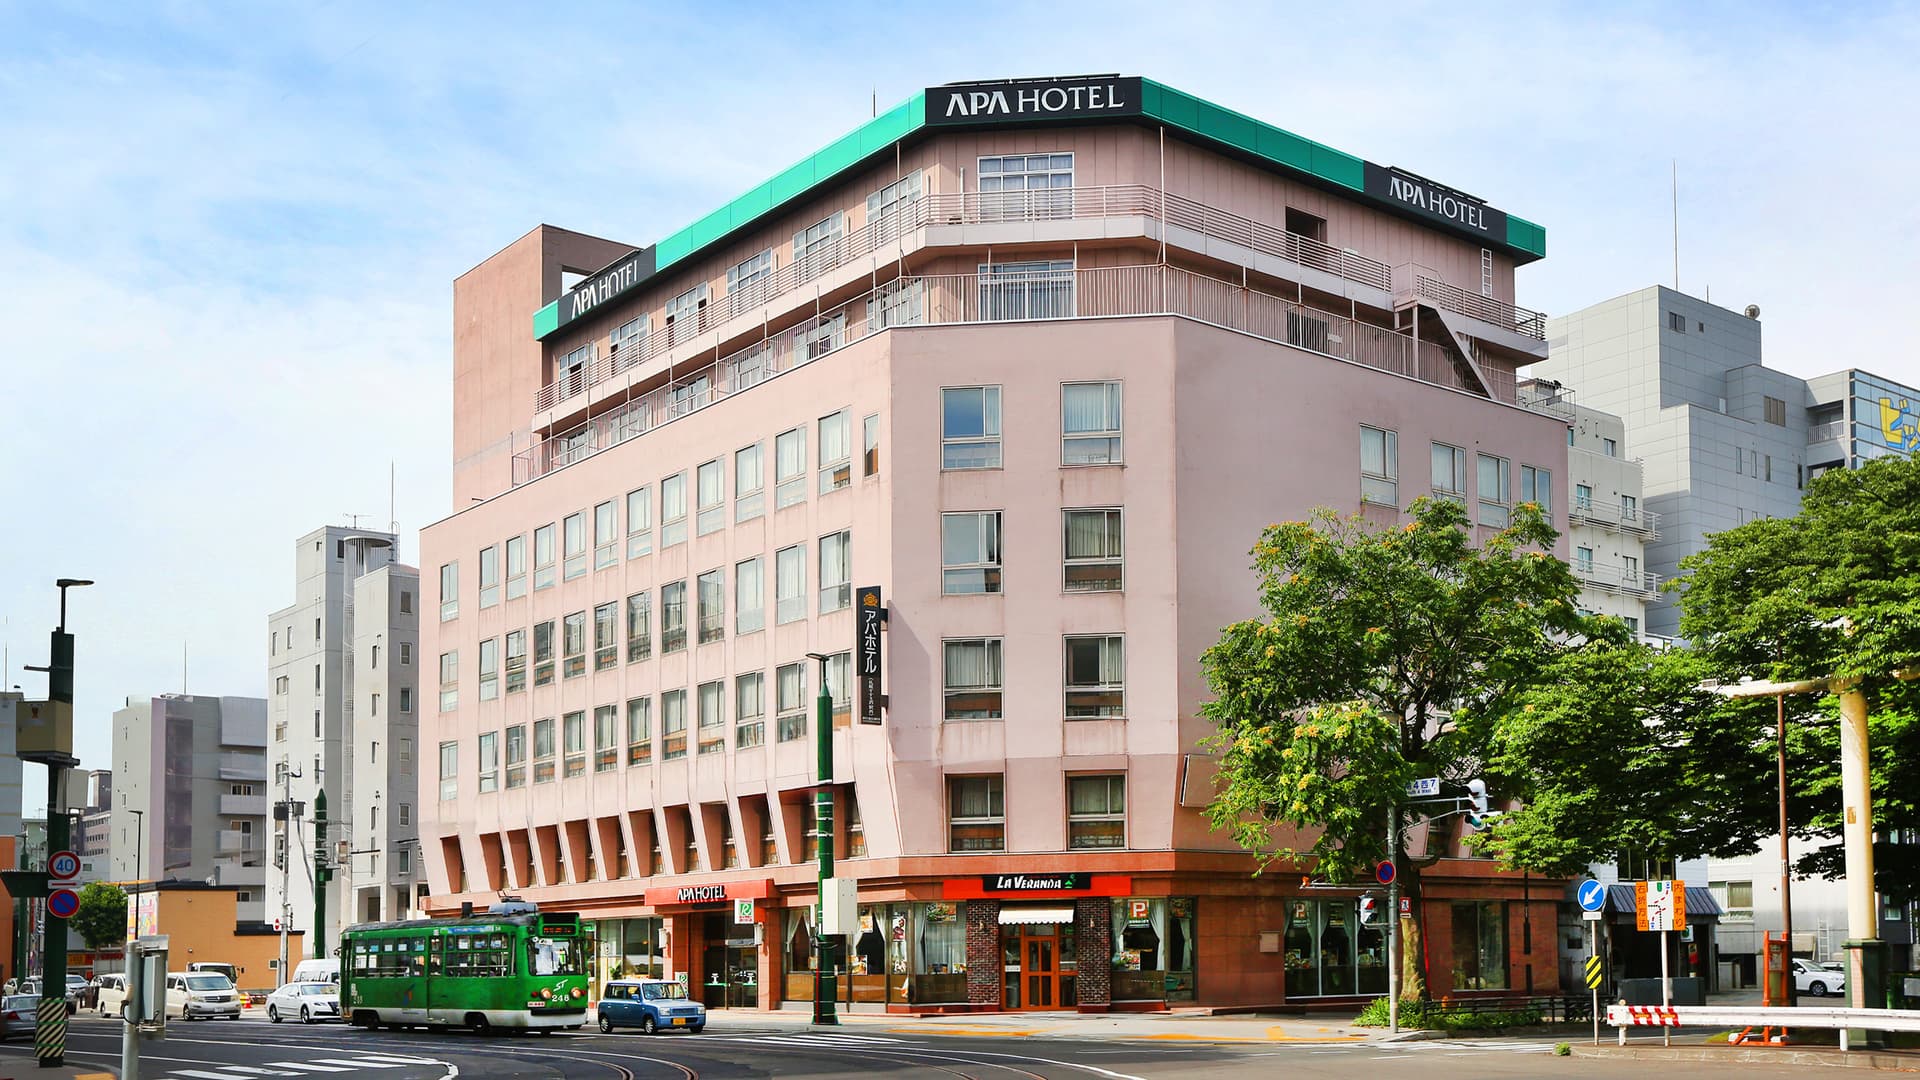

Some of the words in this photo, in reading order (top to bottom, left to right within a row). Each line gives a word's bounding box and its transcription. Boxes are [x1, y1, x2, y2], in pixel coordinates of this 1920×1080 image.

[945, 91, 1011, 117] APA
[1017, 84, 1125, 113] HOTEL
[1389, 176, 1426, 209] APA
[1429, 190, 1488, 231] HOTEL
[571, 283, 597, 321] APA
[598, 259, 638, 304] HOTEL
[1879, 397, 1920, 452] ビッ
[864, 610, 877, 674] アパホテル
[56, 858, 74, 872] 40
[677, 887, 695, 901] APA
[695, 885, 726, 900] HOTEL
[1133, 902, 1146, 917] P
[1673, 883, 1684, 928] 内まわり
